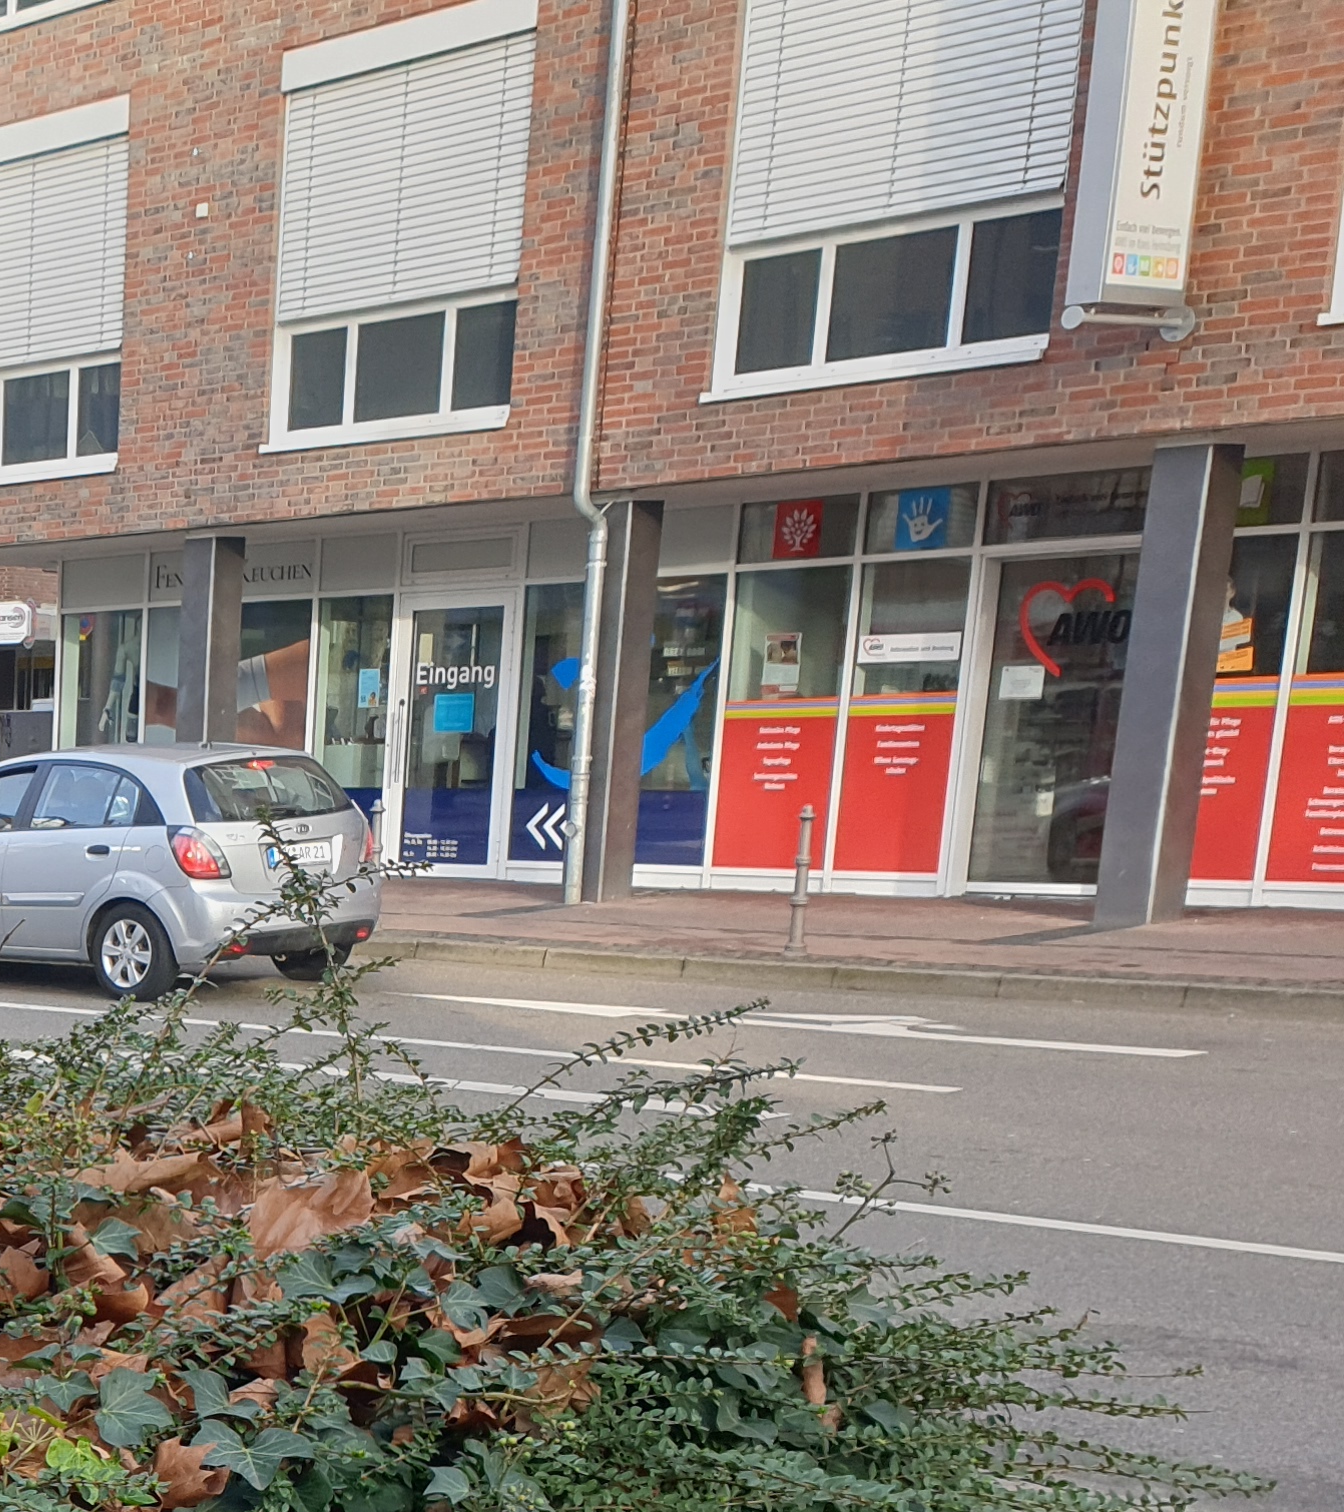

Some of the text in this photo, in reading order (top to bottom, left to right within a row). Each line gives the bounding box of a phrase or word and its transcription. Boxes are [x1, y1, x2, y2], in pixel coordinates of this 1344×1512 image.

[1140, 0, 1184, 200] Stützpunk
[154, 564, 184, 589] FEN
[1047, 609, 1132, 646] AWO
[416, 662, 495, 689] Eingang
[313, 845, 326, 859] 21
